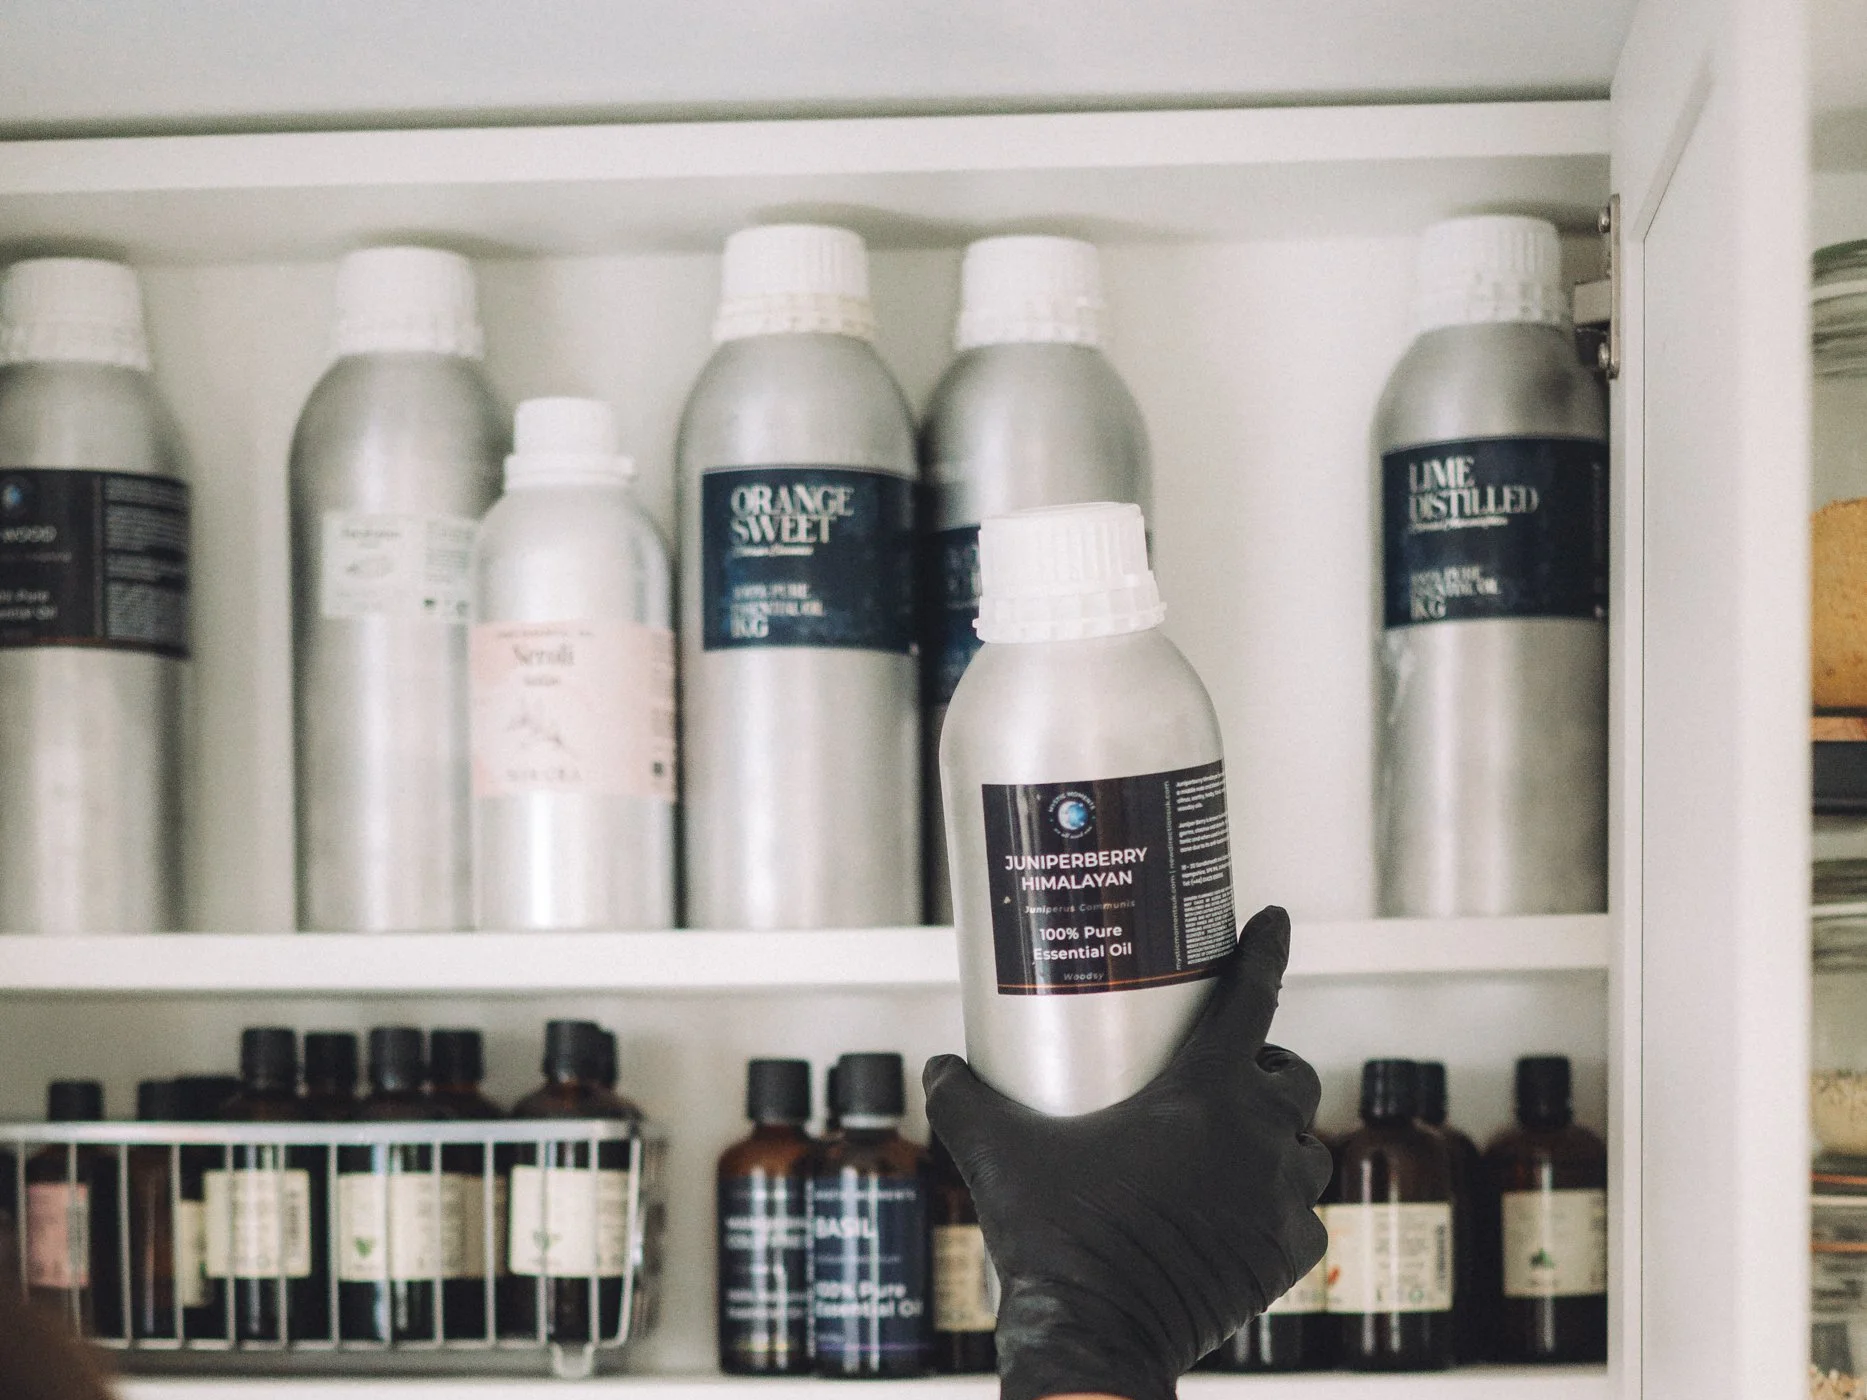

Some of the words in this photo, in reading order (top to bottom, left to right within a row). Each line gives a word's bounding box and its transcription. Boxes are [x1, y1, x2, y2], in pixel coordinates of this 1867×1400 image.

[730, 482, 855, 518] ORANGE
[730, 514, 836, 545] SWEET
[1164, 780, 1177, 869] newdirectionsuk.com
[1005, 847, 1148, 871] JUNIPERBERRY
[1021, 870, 1133, 892] HIMALAYAN
[1024, 903, 1076, 915] Juniperus
[1039, 927, 1080, 941] 100%
[1084, 925, 1123, 939] Pure
[1169, 875, 1182, 971] mysticmomentsuk.com
[1034, 945, 1105, 961] Essential
[1109, 942, 1132, 957] Oil
